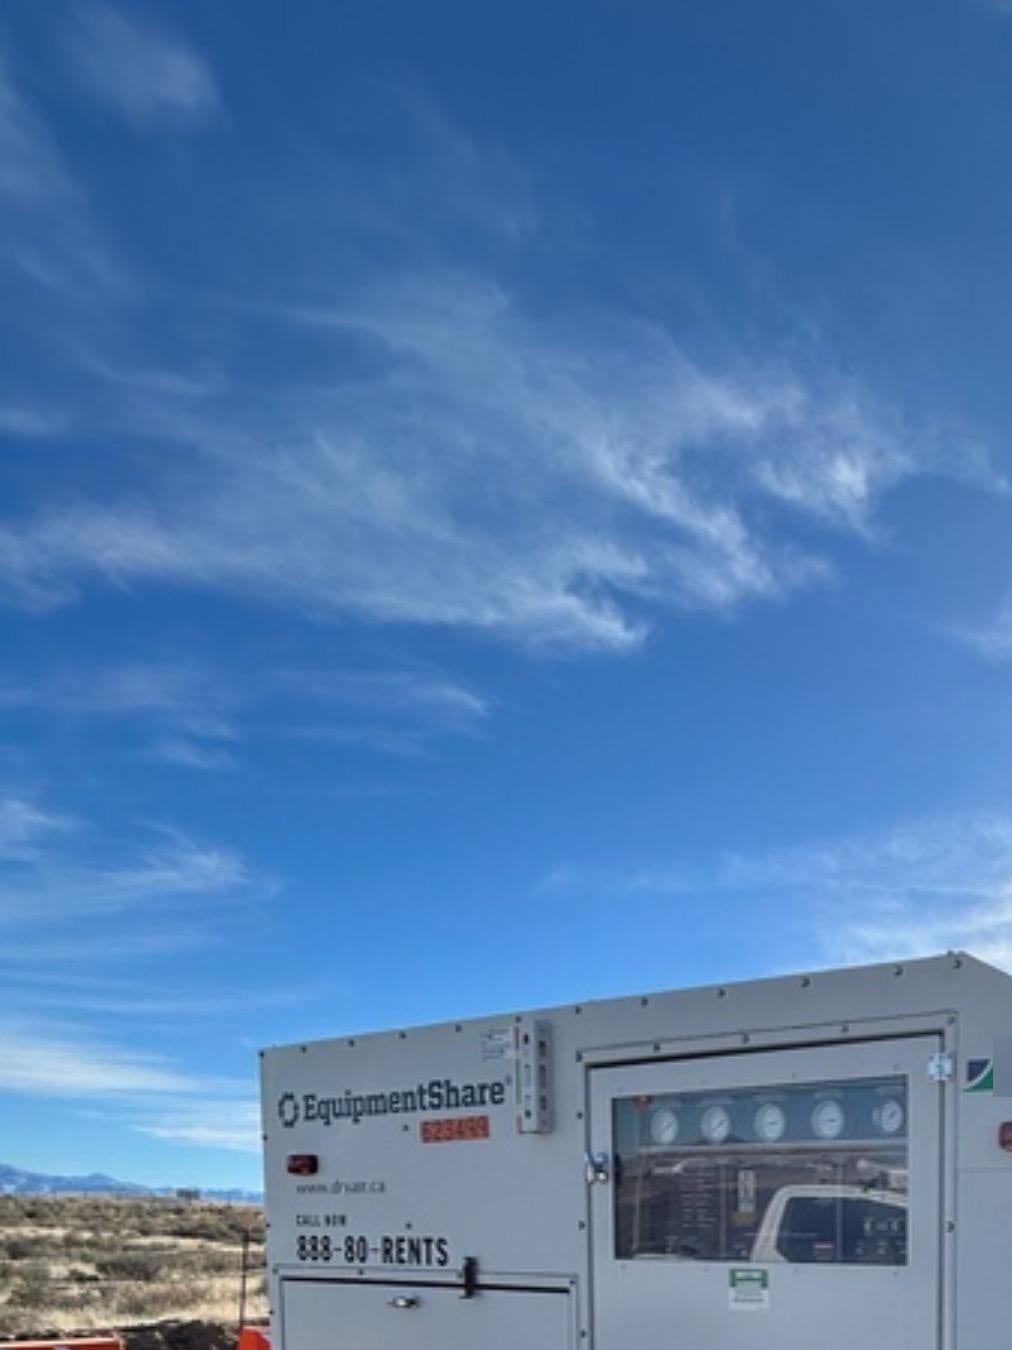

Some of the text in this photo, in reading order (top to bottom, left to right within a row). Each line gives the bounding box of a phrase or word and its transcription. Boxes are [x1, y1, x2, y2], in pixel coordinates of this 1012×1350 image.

[303, 1079, 505, 1126] EquipmentShare
[296, 1214, 347, 1227] CALL NOW
[297, 1235, 449, 1267] 888-80-RENTS
